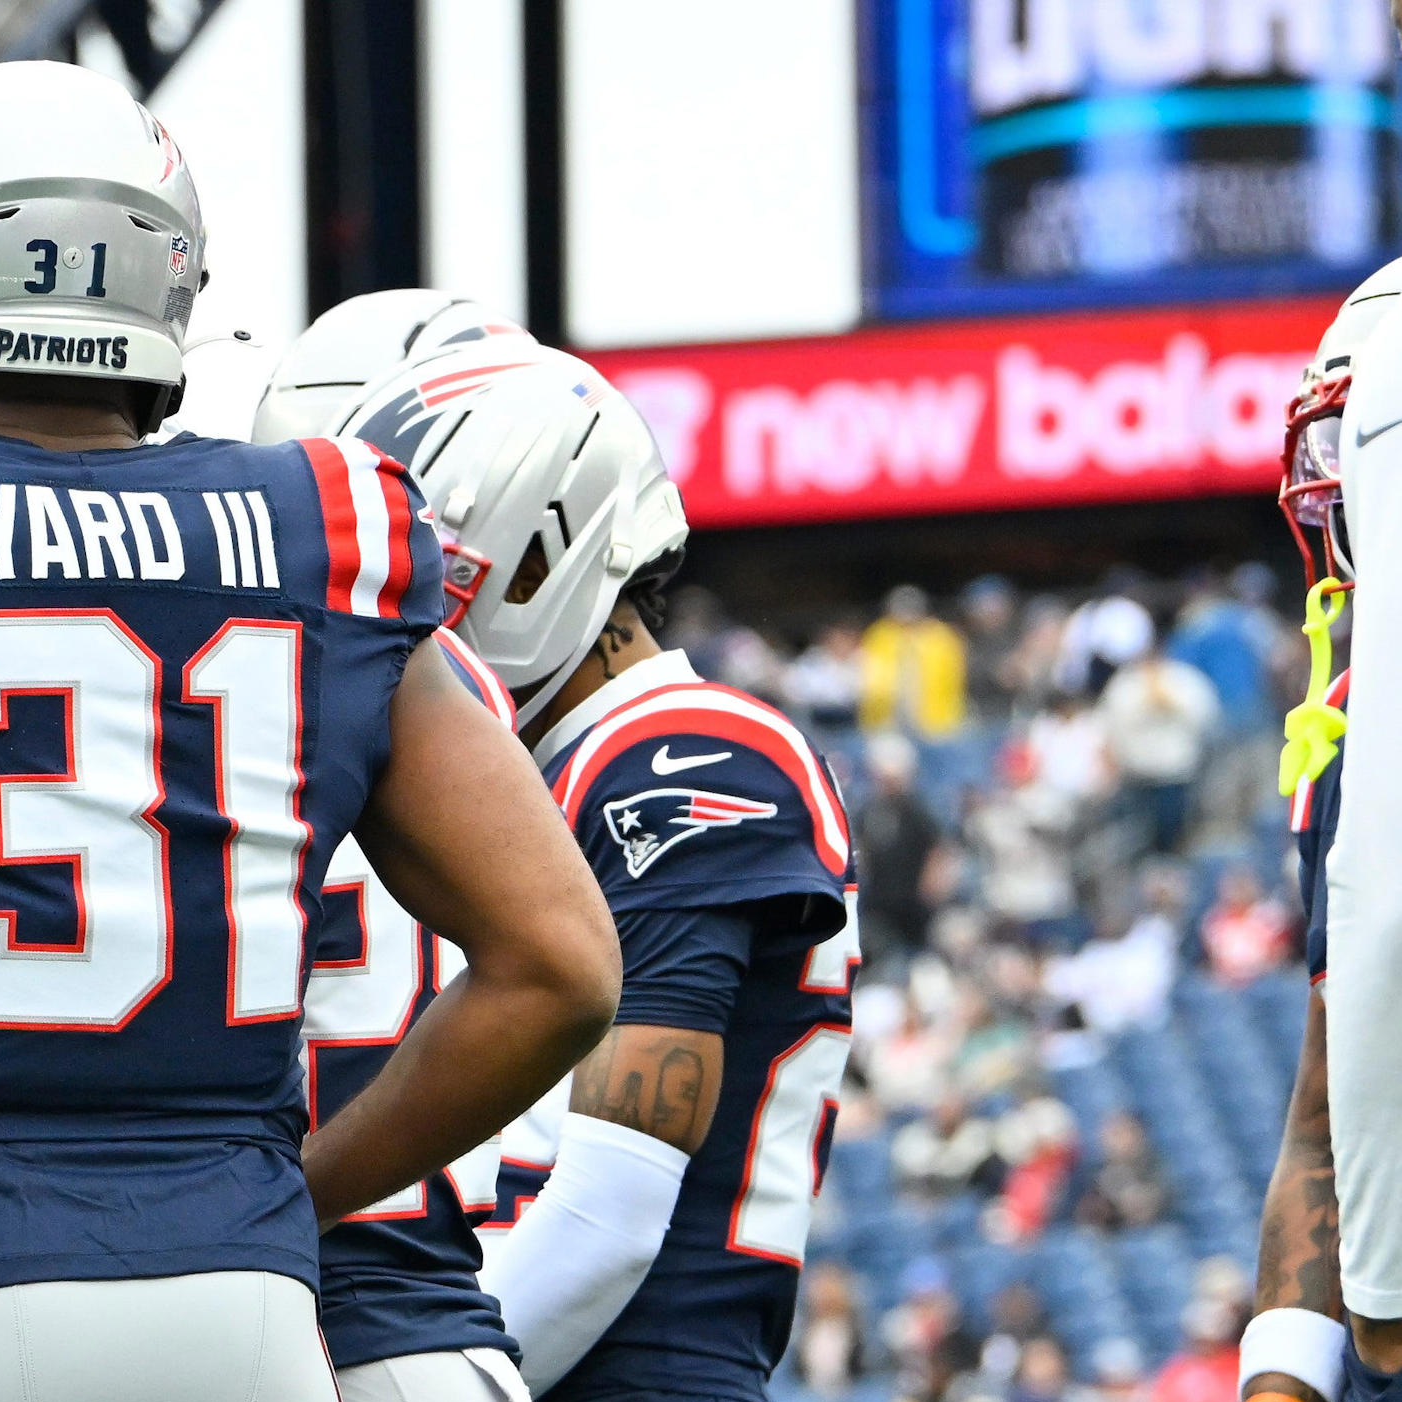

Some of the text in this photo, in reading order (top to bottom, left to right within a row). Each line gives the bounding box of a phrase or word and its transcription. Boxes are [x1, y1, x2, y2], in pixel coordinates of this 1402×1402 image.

[171, 250, 185, 272] NFL
[722, 332, 1315, 498] new bala
[203, 490, 281, 591] III
